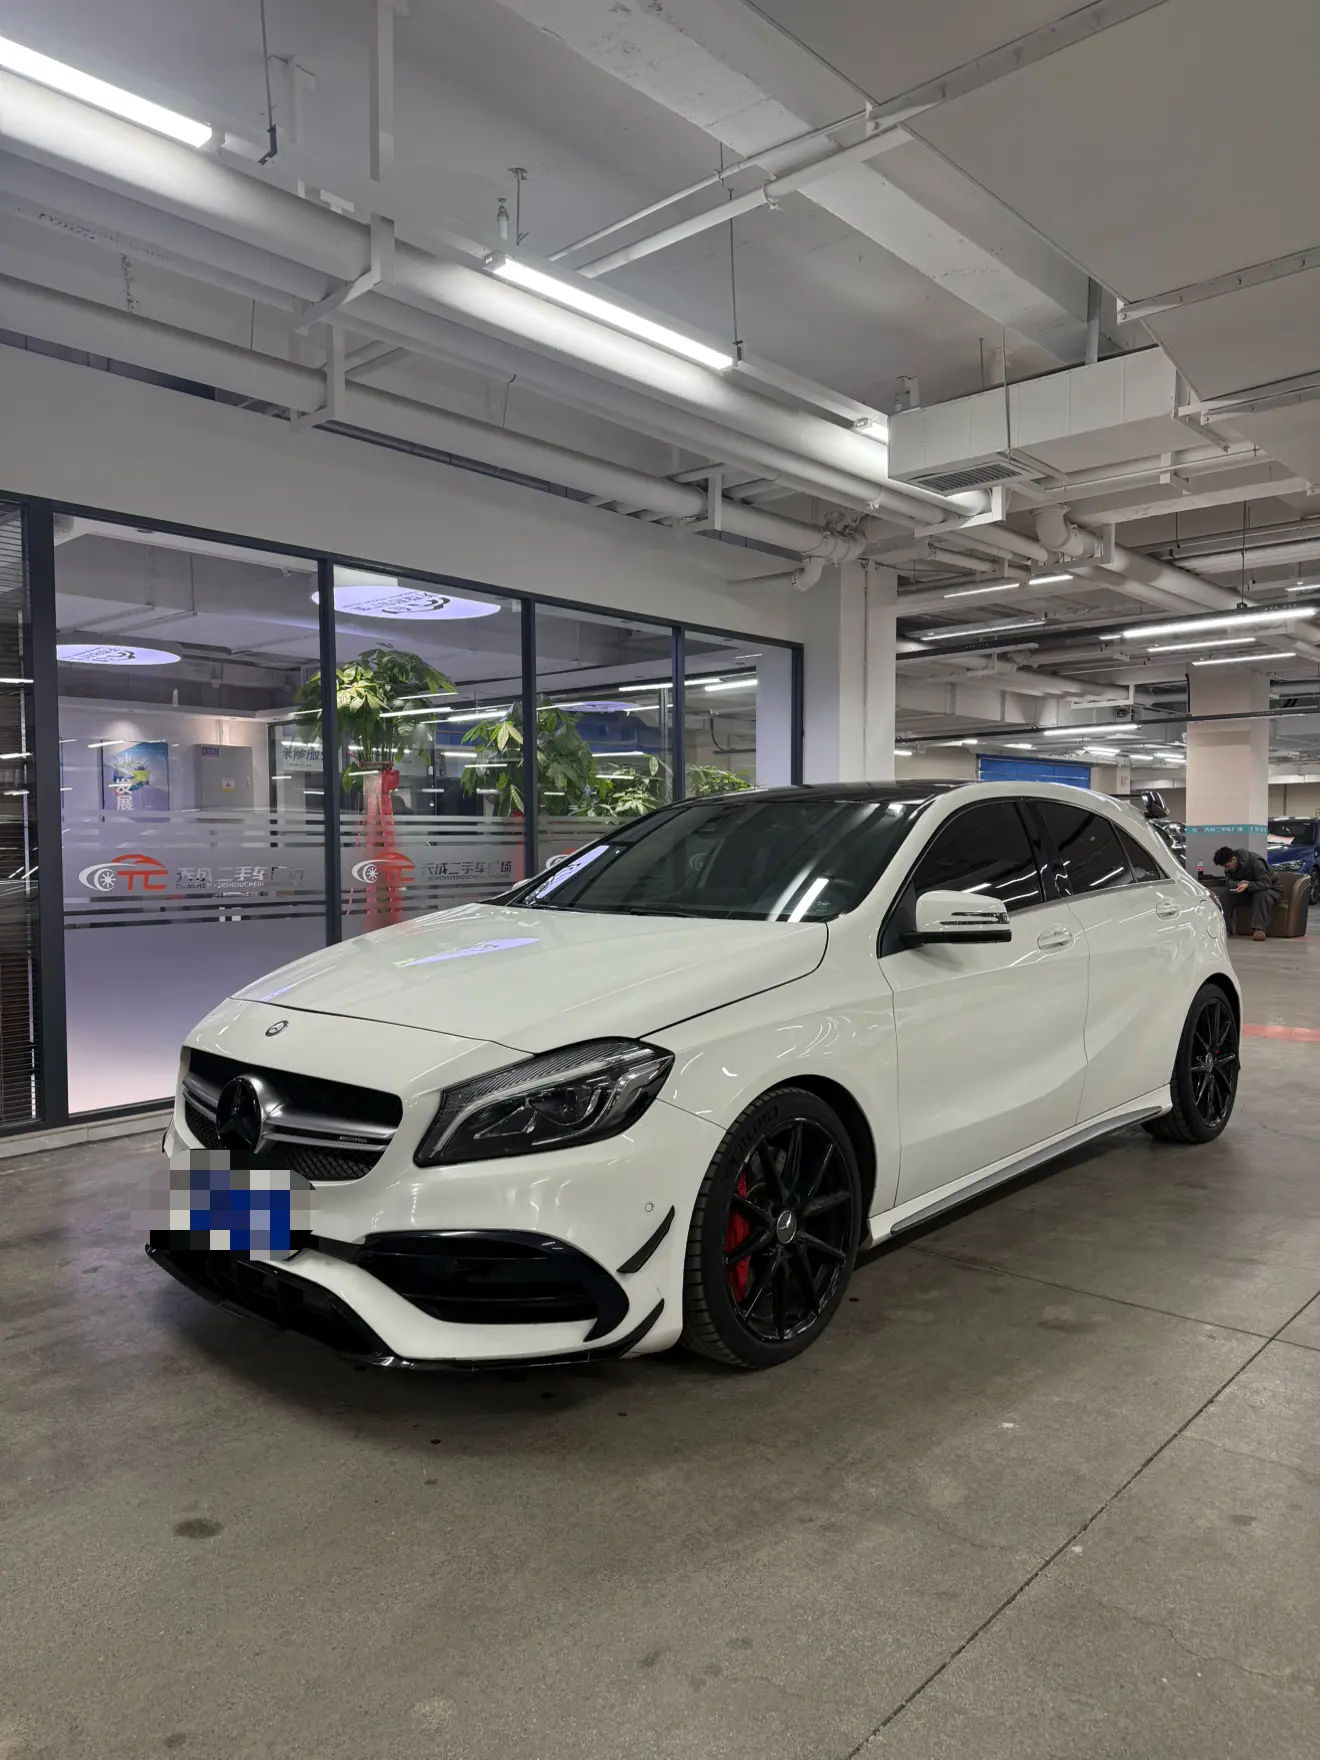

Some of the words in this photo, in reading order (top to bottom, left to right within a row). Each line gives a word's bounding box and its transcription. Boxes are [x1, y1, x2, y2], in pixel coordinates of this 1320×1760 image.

[115, 778, 133, 811] 发展
[422, 861, 512, 875] 天成二手车广场
